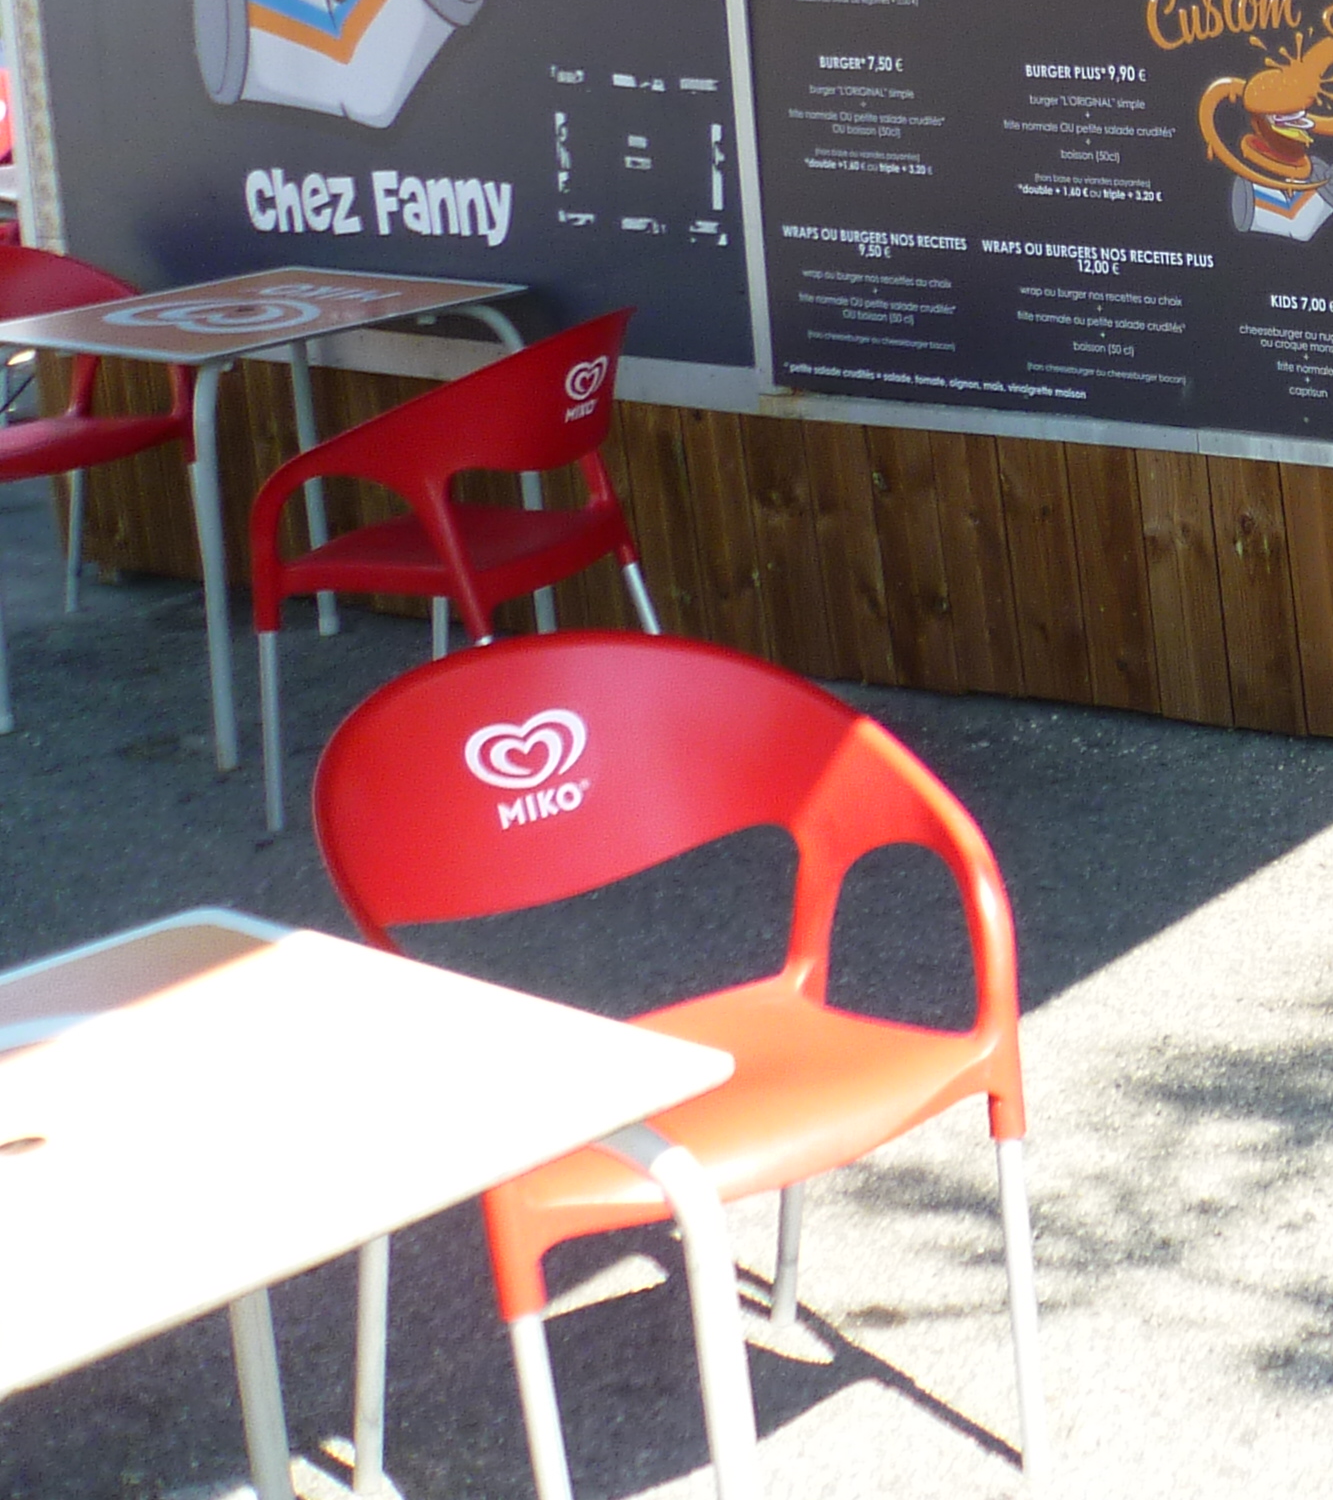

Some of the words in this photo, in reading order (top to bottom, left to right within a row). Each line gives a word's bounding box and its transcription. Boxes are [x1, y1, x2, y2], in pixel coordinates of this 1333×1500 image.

[245, 167, 363, 235] Chez
[371, 170, 513, 247] Fanny
[1270, 293, 1299, 310] KIDS
[1300, 294, 1328, 313] 7,00
[496, 787, 580, 831] MIKO
